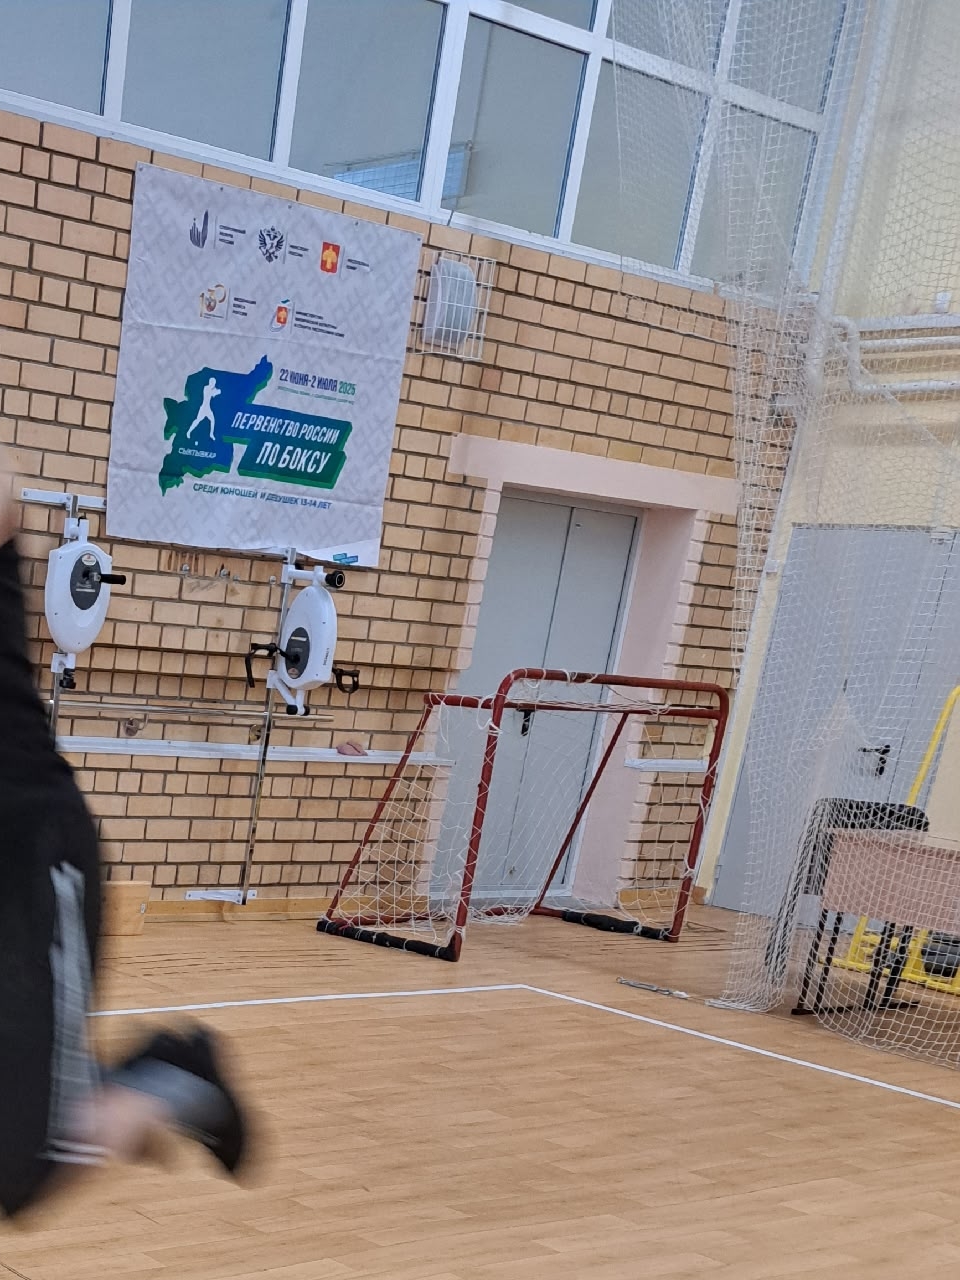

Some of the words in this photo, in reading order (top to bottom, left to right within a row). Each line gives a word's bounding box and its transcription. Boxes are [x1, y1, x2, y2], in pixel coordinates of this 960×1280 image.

[280, 368, 289, 382] 22
[338, 381, 357, 396] 2025
[231, 411, 300, 437] ПЕРВЕНСТВО
[298, 423, 341, 445] РОССИИ
[256, 441, 281, 467] ПО
[278, 445, 331, 474] БОКСУ
[193, 483, 220, 494] СРЕДИ
[219, 486, 258, 499] ЮНОШЕЙ
[265, 493, 300, 506] ДЕВУШЕК
[317, 501, 333, 510] ЛЕТ
